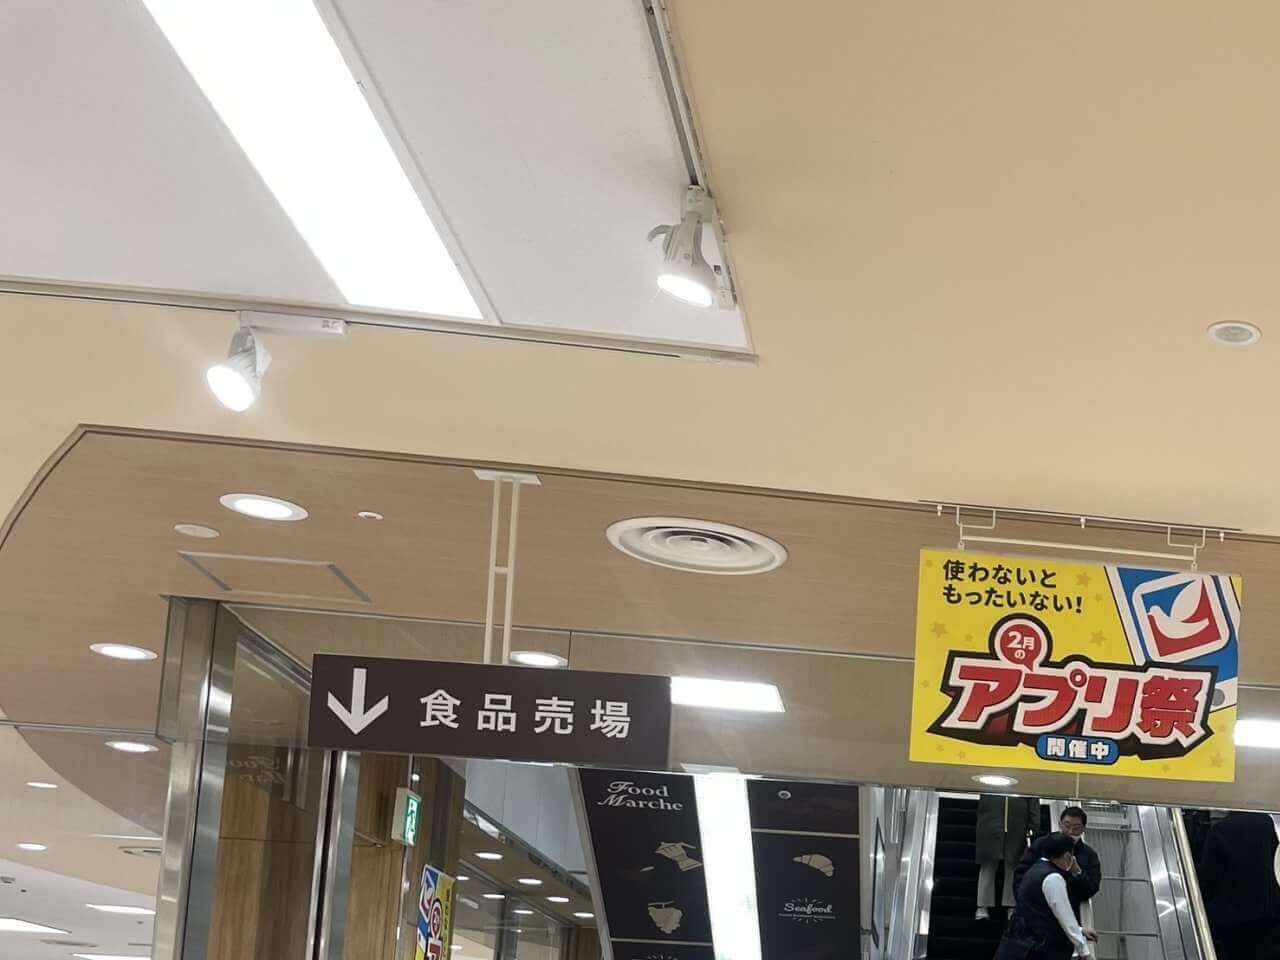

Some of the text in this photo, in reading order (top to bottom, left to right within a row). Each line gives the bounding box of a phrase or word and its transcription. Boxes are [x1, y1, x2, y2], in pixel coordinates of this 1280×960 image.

[942, 559, 1057, 589] 使わないと
[943, 584, 1083, 614] もったいない!
[1007, 631, 1035, 650] 2月
[420, 688, 632, 739] 食品売場
[956, 664, 1204, 740] アプリ祭
[1046, 738, 1110, 761] 開催中
[607, 781, 669, 797] Food
[598, 794, 683, 811] Marche
[784, 902, 833, 914] Seafood
